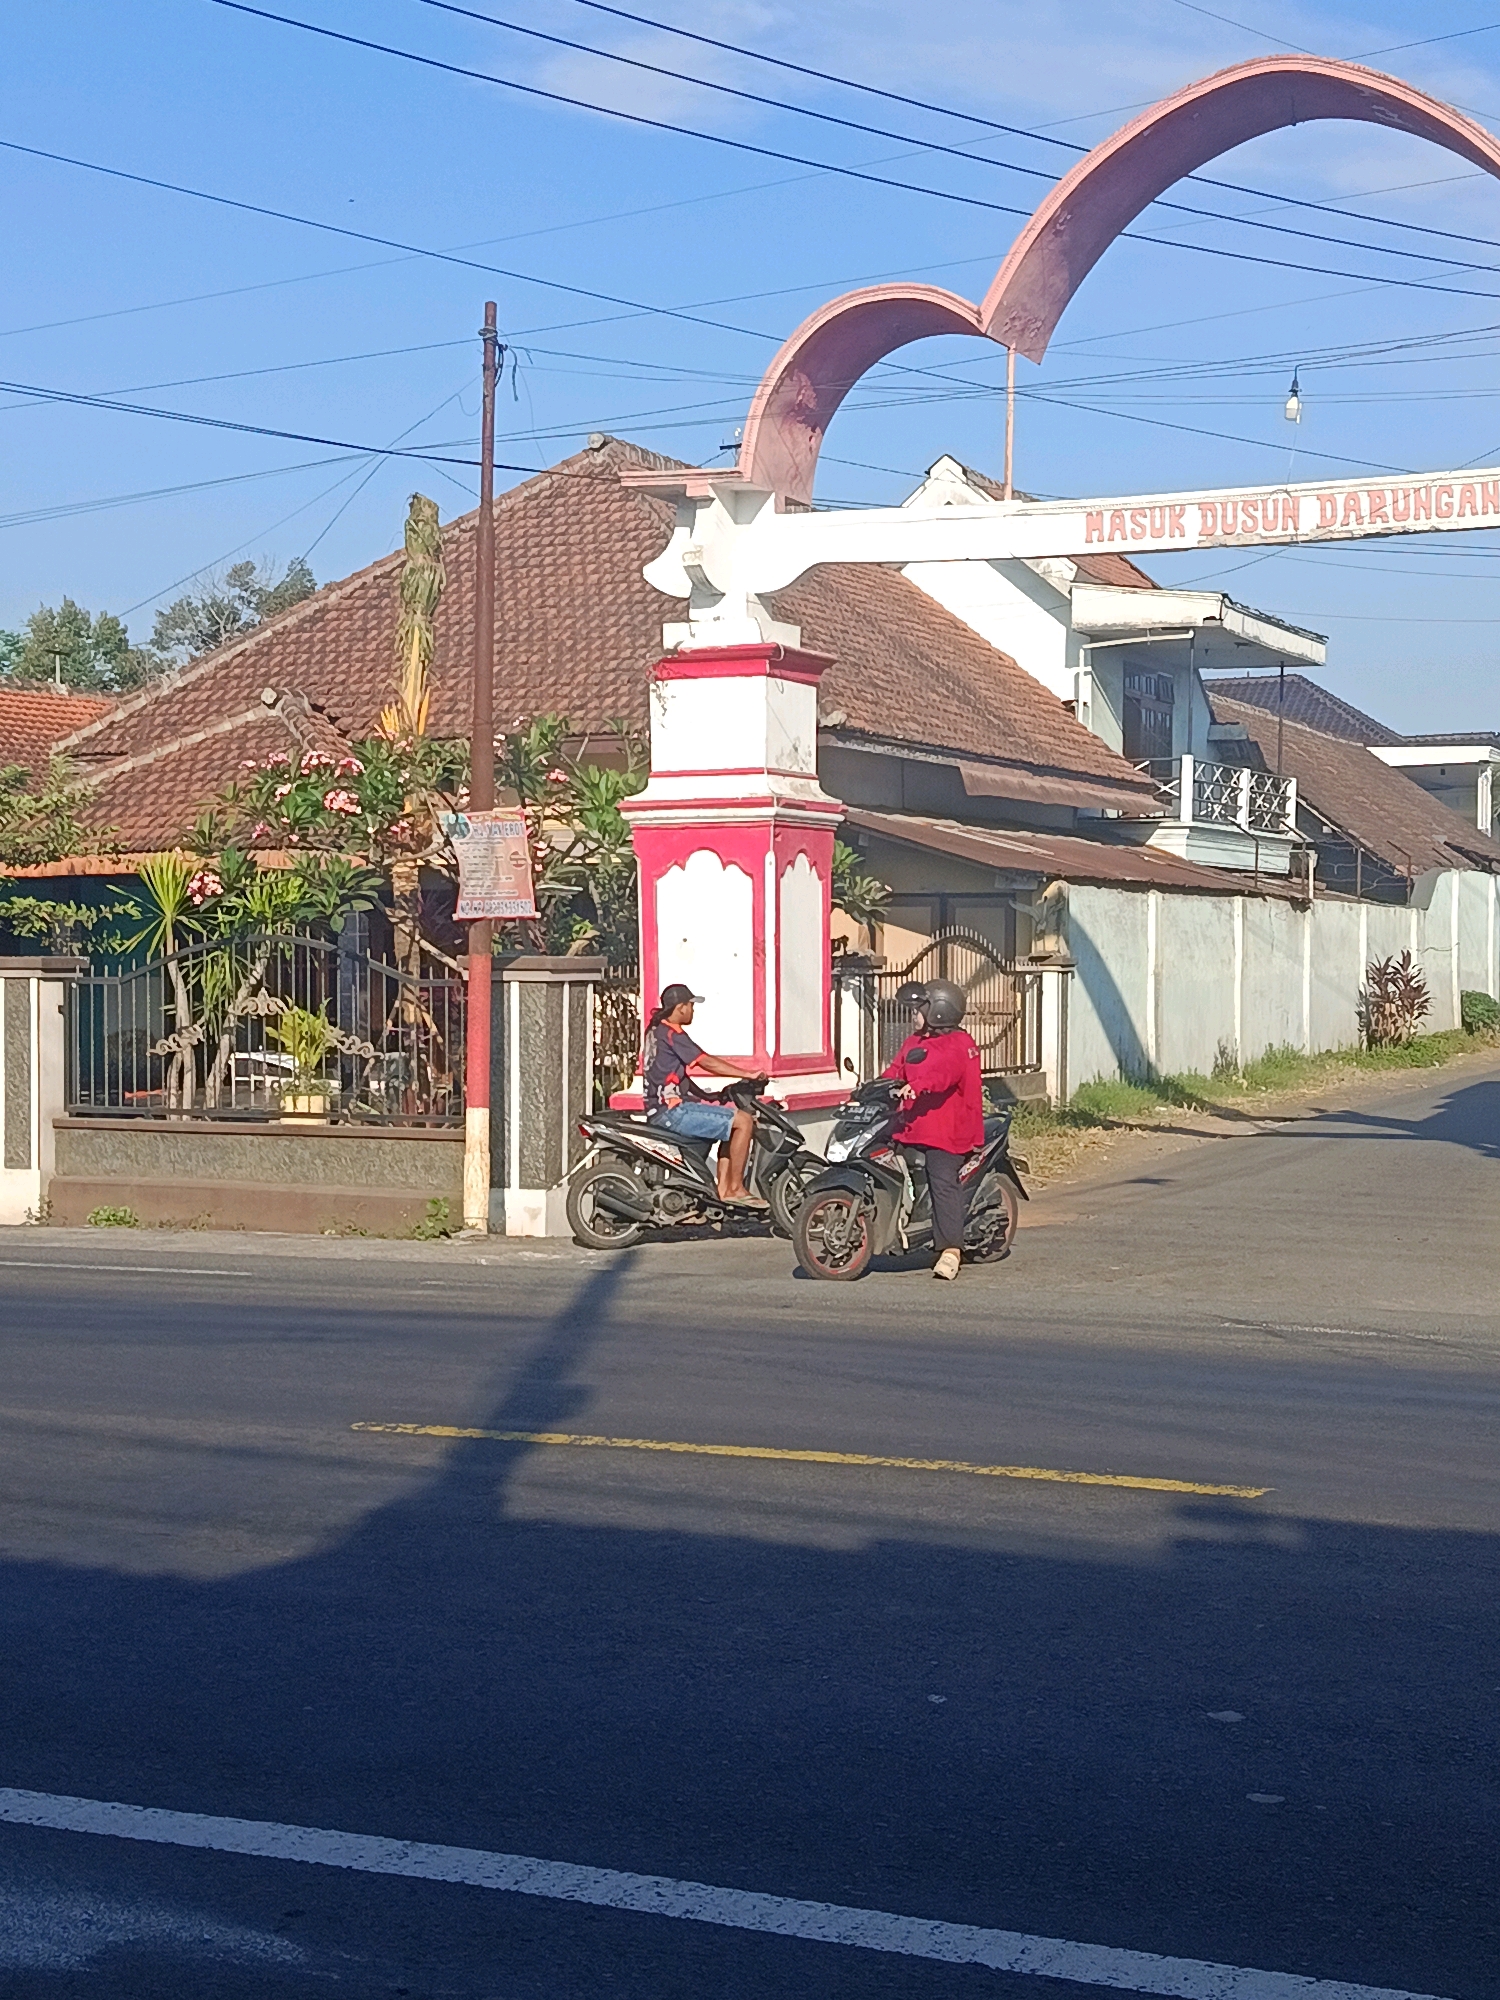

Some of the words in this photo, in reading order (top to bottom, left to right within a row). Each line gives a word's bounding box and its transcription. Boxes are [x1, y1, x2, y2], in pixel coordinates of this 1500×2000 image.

[1085, 505, 1186, 543] MASUK
[1198, 496, 1300, 536] DUSUN
[1316, 480, 1499, 529] DARUNGAN
